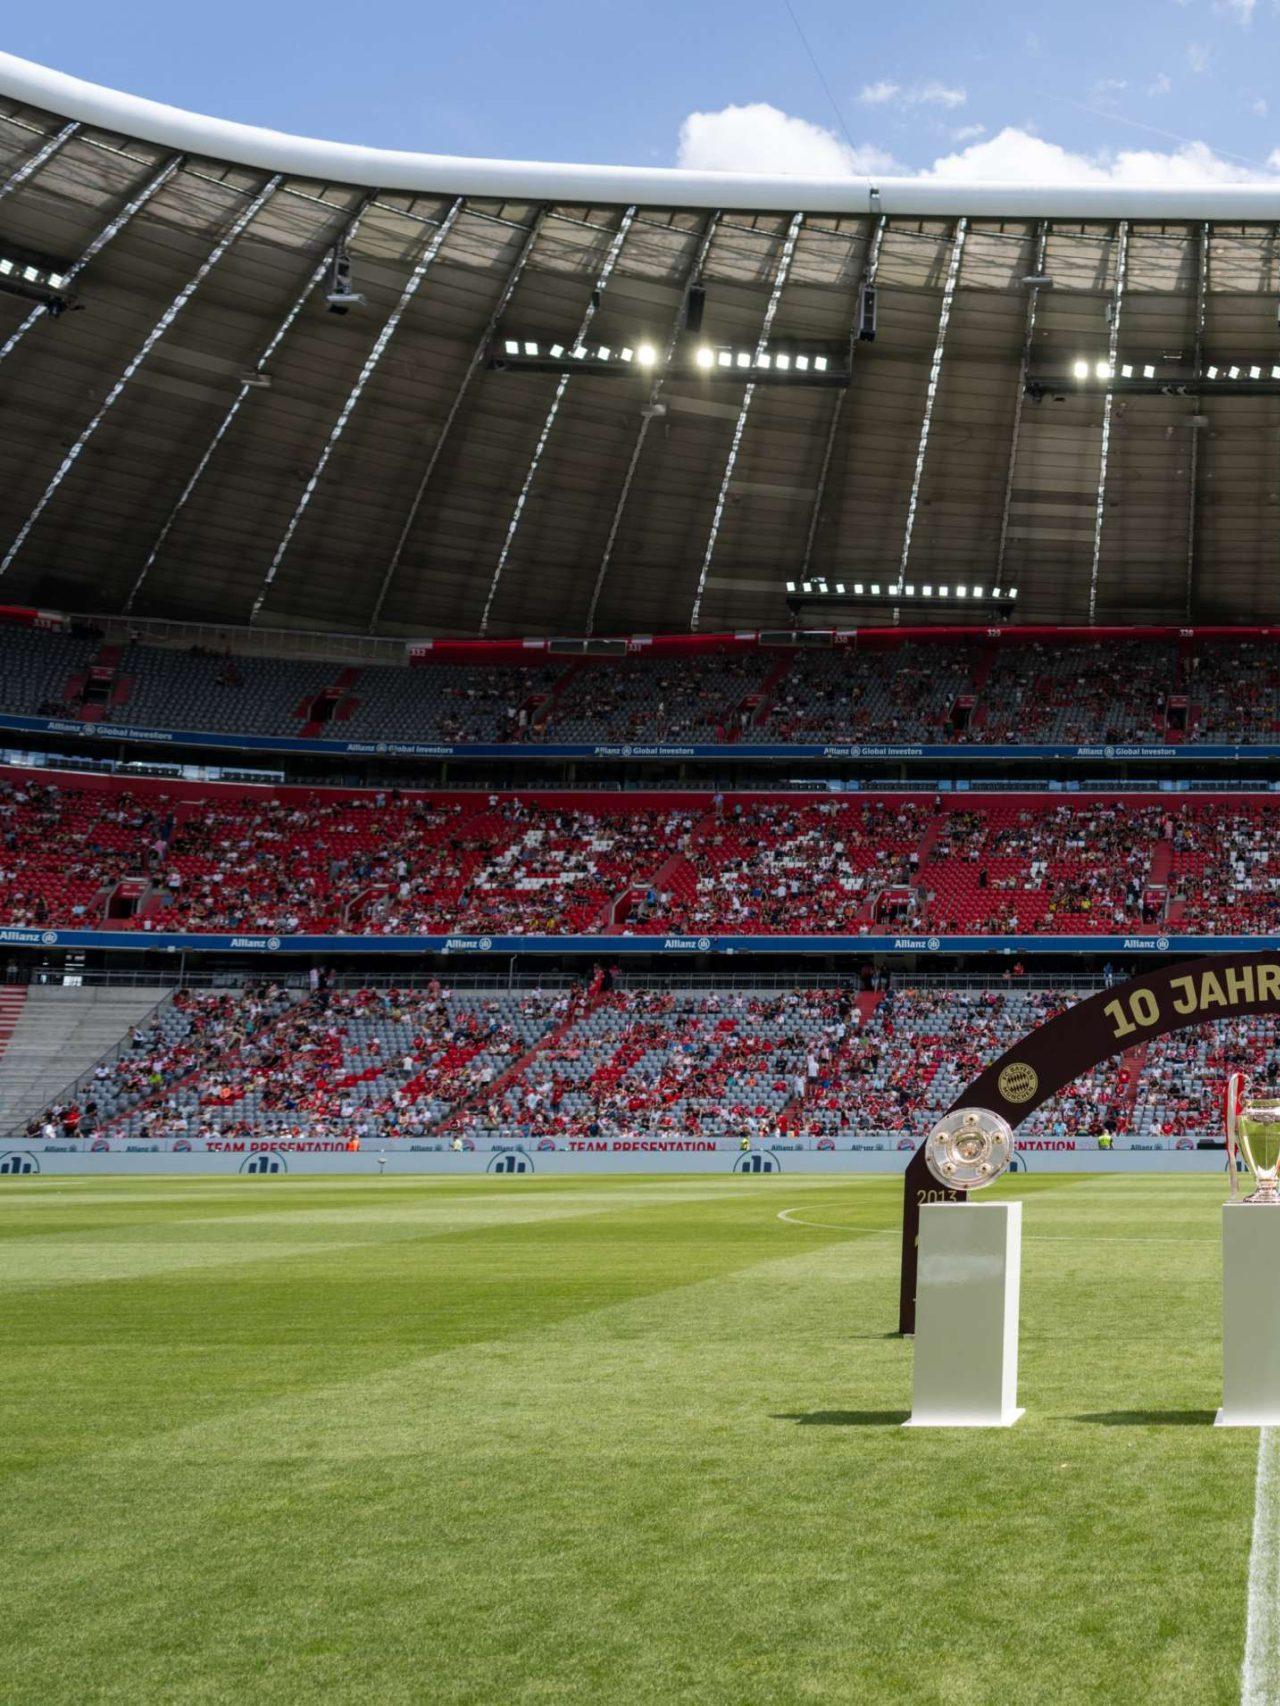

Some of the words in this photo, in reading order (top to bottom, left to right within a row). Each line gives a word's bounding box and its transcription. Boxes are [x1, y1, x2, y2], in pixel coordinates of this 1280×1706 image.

[47, 721, 81, 732] Allianz
[97, 727, 128, 737] Global
[130, 729, 173, 740] Investors
[346, 744, 374, 752] Allianz
[388, 745, 415, 753] Global
[416, 746, 454, 754] Investors
[633, 747, 658, 755] Global
[659, 747, 694, 755] Investors
[823, 747, 850, 755] Allianz
[862, 747, 887, 755] Global
[888, 747, 922, 755] Investors
[1077, 747, 1103, 755] Allianz
[1116, 747, 1141, 755] Global
[1141, 747, 1176, 755] Investors
[0, 931, 40, 942] Allianz
[230, 938, 266, 948] Allianz
[446, 939, 477, 948] Allianz
[664, 939, 696, 948] Allianz
[894, 939, 926, 948] Allianz
[1123, 939, 1155, 948] Allianz
[1103, 987, 1160, 1038] 10
[206, 1142, 245, 1151] TEAM
[250, 1142, 349, 1151] PRESENTATIO
[569, 1142, 607, 1151] TEAM
[612, 1142, 716, 1151] PRESENTATION
[917, 1189, 957, 1203] 2013
